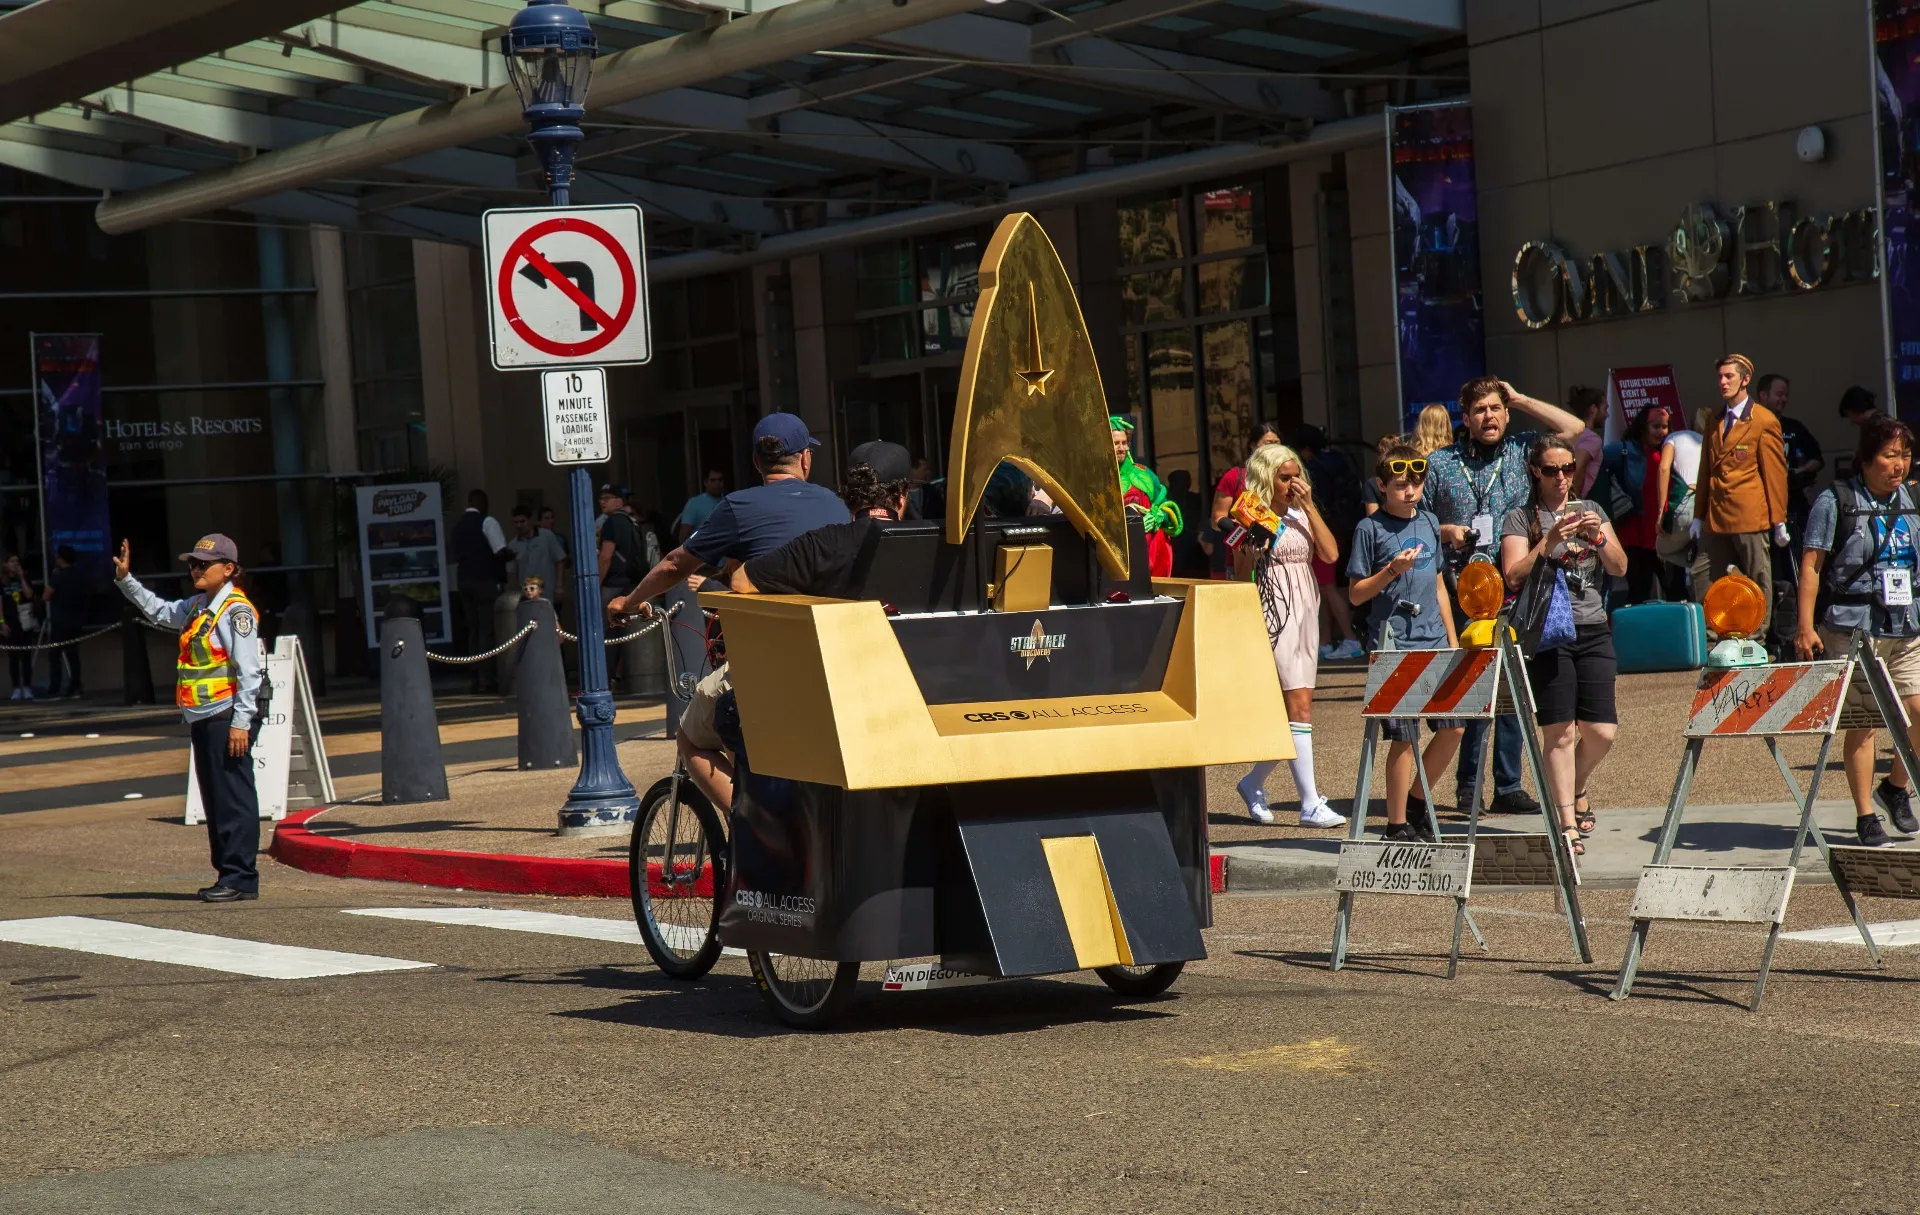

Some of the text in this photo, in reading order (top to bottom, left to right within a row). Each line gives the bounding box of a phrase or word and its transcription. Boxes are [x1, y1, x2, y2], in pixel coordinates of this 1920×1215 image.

[1512, 240, 1660, 329] OMNI
[566, 376, 582, 393] 10
[1621, 388, 1647, 398] EVENT IS
[558, 397, 593, 410] MINUTE
[1651, 397, 1659, 405] AT
[556, 413, 598, 423] PASSENGER
[105, 416, 263, 438] HOTELS & RESORTS
[562, 424, 593, 434] LOADING
[119, 439, 184, 452] san diego
[563, 437, 594, 446] 24 HOURS
[571, 447, 587, 455] DAILY
[377, 494, 418, 508] PAYLOAD
[388, 503, 413, 515] TOUR
[1010, 633, 1067, 650] STAR TREK
[1020, 649, 1051, 657] DISCOVERY
[963, 703, 1148, 723] CBS ALL ACCESS
[1376, 845, 1437, 869] ACME
[1351, 870, 1452, 892] 619-299-5100
[736, 889, 815, 914] CBS ALL ACCESS
[747, 909, 802, 928] ORIGINAL SERIES
[888, 971, 914, 983] SAN
[916, 969, 954, 982] DIEGO
